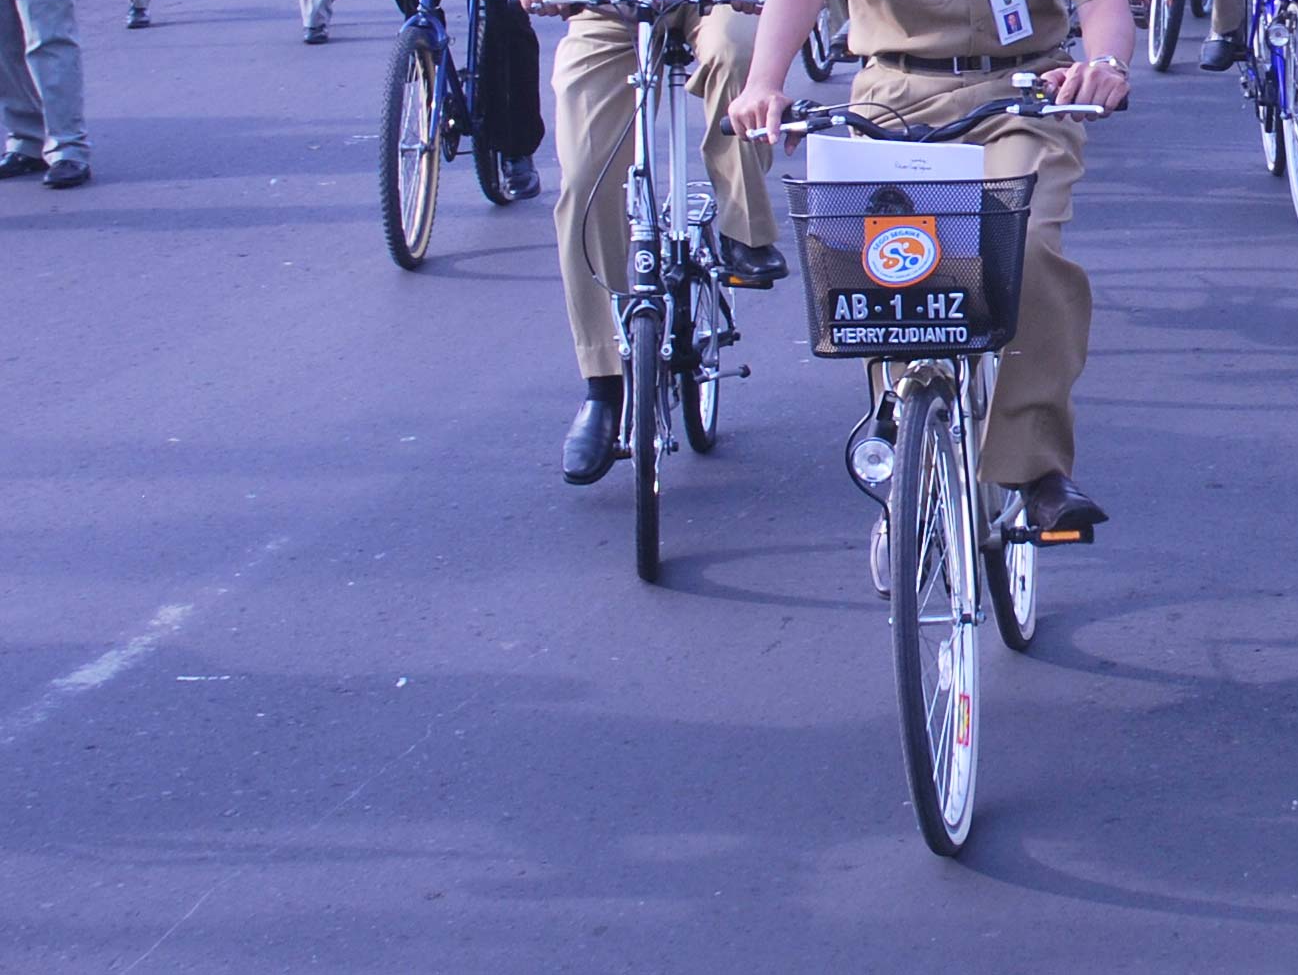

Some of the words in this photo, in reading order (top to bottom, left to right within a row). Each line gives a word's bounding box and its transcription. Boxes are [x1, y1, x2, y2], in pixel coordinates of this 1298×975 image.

[834, 293, 868, 321] AB
[889, 293, 902, 320] 1
[927, 293, 964, 319] HZ
[832, 327, 886, 344] HERRY
[888, 326, 967, 343] ZUDIANTO
